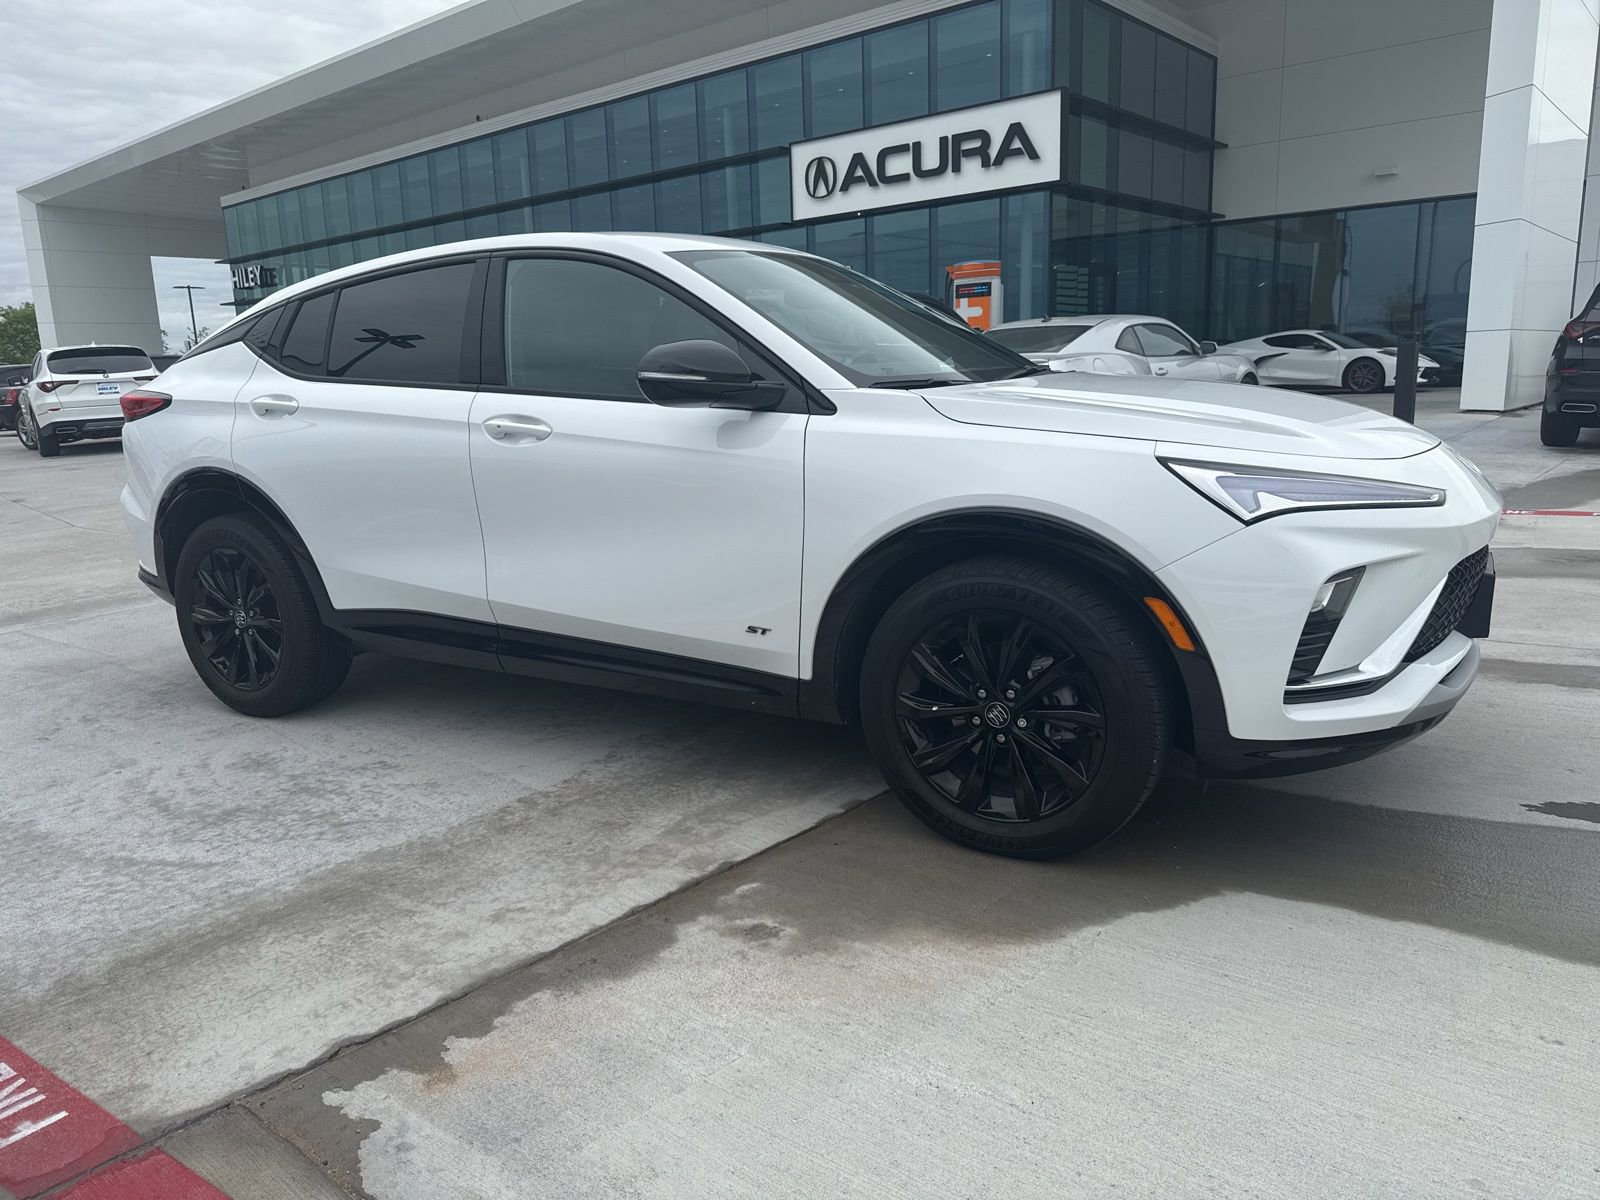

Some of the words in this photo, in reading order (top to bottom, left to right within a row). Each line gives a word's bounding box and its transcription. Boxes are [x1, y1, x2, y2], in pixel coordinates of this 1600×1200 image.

[839, 121, 1040, 193] ACURA
[231, 265, 261, 289] HILEY
[745, 625, 772, 635] ST
